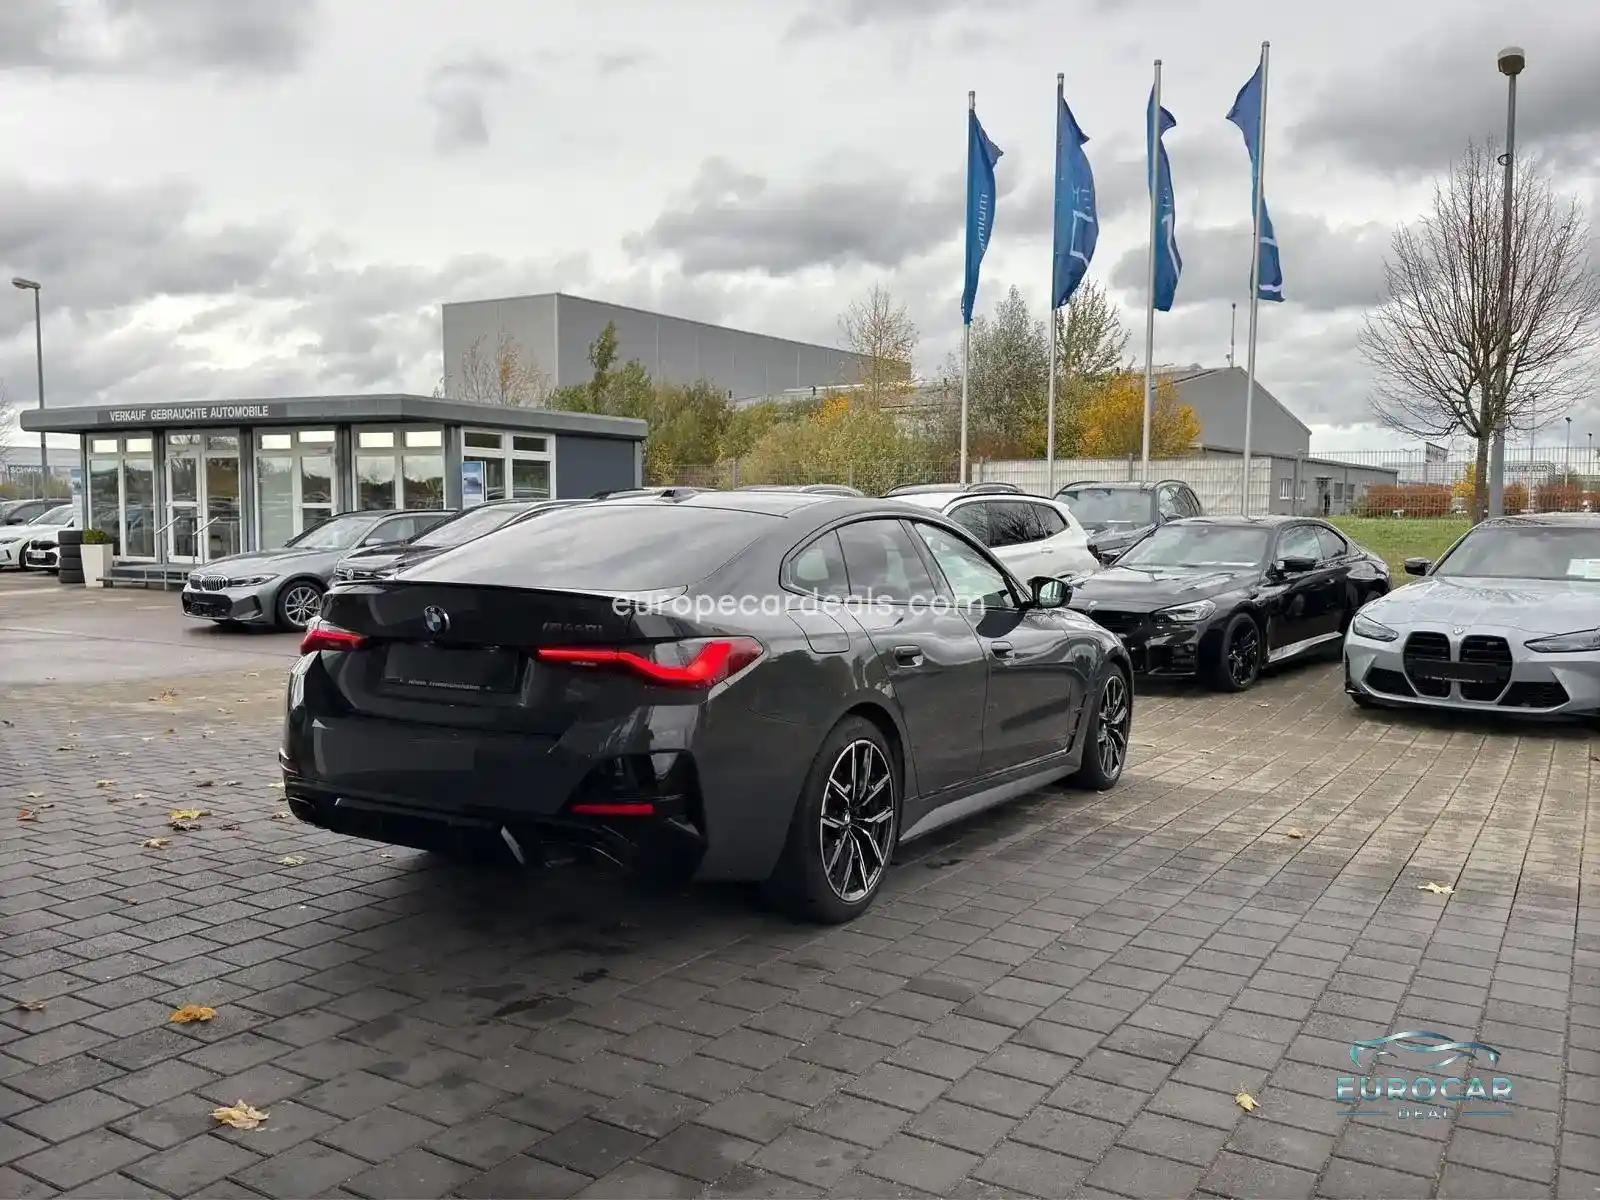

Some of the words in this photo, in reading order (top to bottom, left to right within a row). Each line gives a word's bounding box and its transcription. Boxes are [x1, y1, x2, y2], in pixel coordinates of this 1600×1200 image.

[109, 409, 147, 422] VERKAUF
[150, 407, 207, 420] GEBRAUCHTE
[210, 405, 269, 418] AUTOMOBILE
